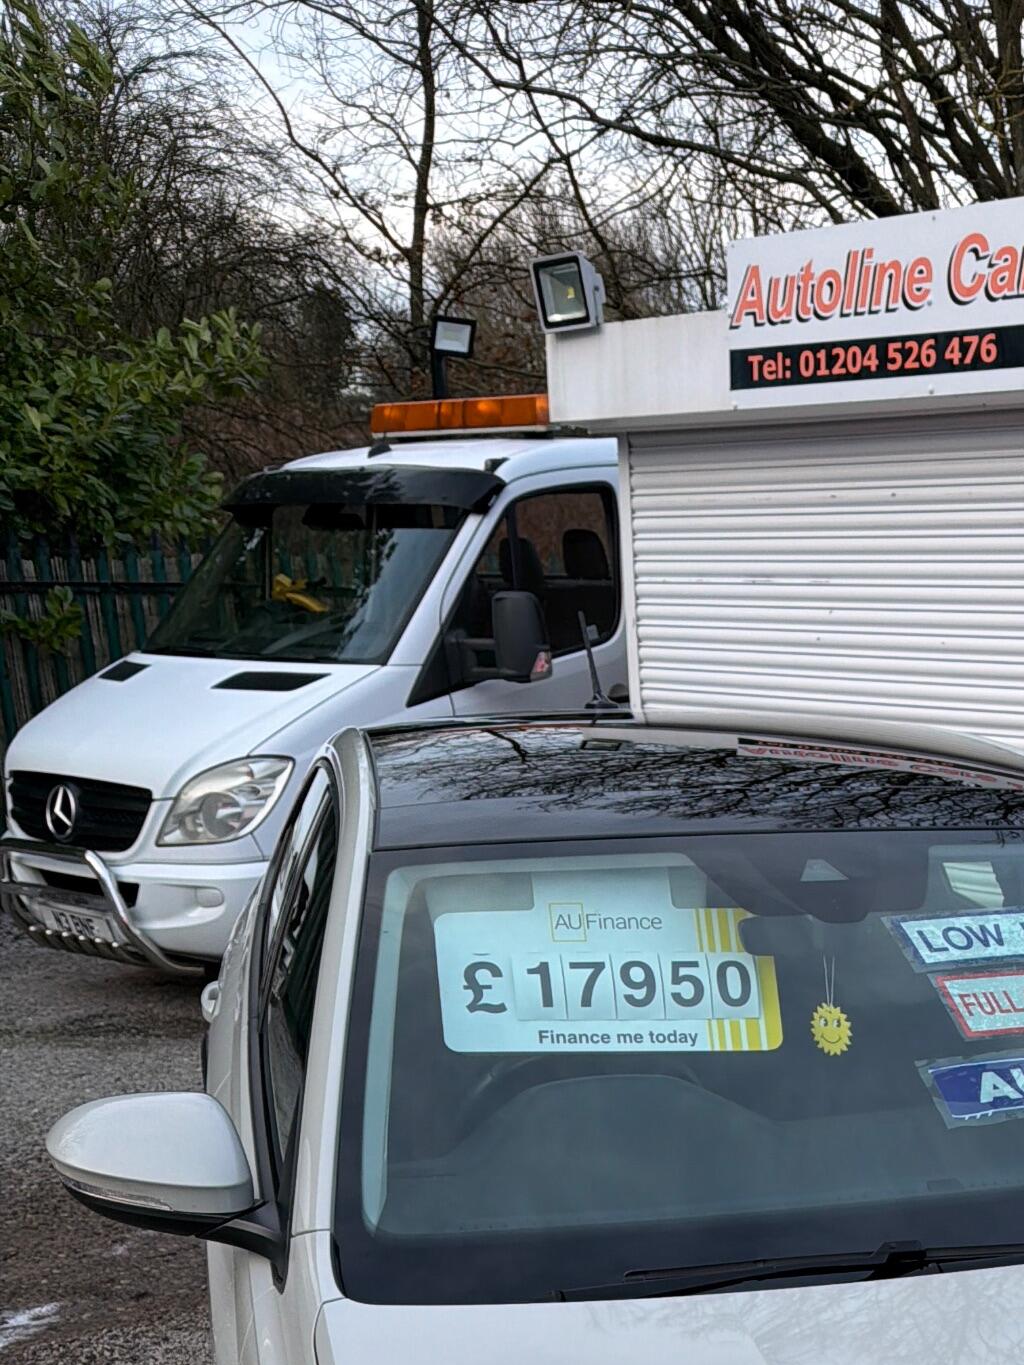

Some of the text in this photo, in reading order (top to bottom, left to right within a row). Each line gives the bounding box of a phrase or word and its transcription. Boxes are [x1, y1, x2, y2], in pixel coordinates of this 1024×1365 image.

[729, 247, 933, 329] Autoline
[747, 333, 998, 381] Tel: 01204 526 476
[916, 922, 1005, 954] LOW
[958, 989, 1024, 1018] FULL
[538, 1029, 699, 1048] Finance me today
